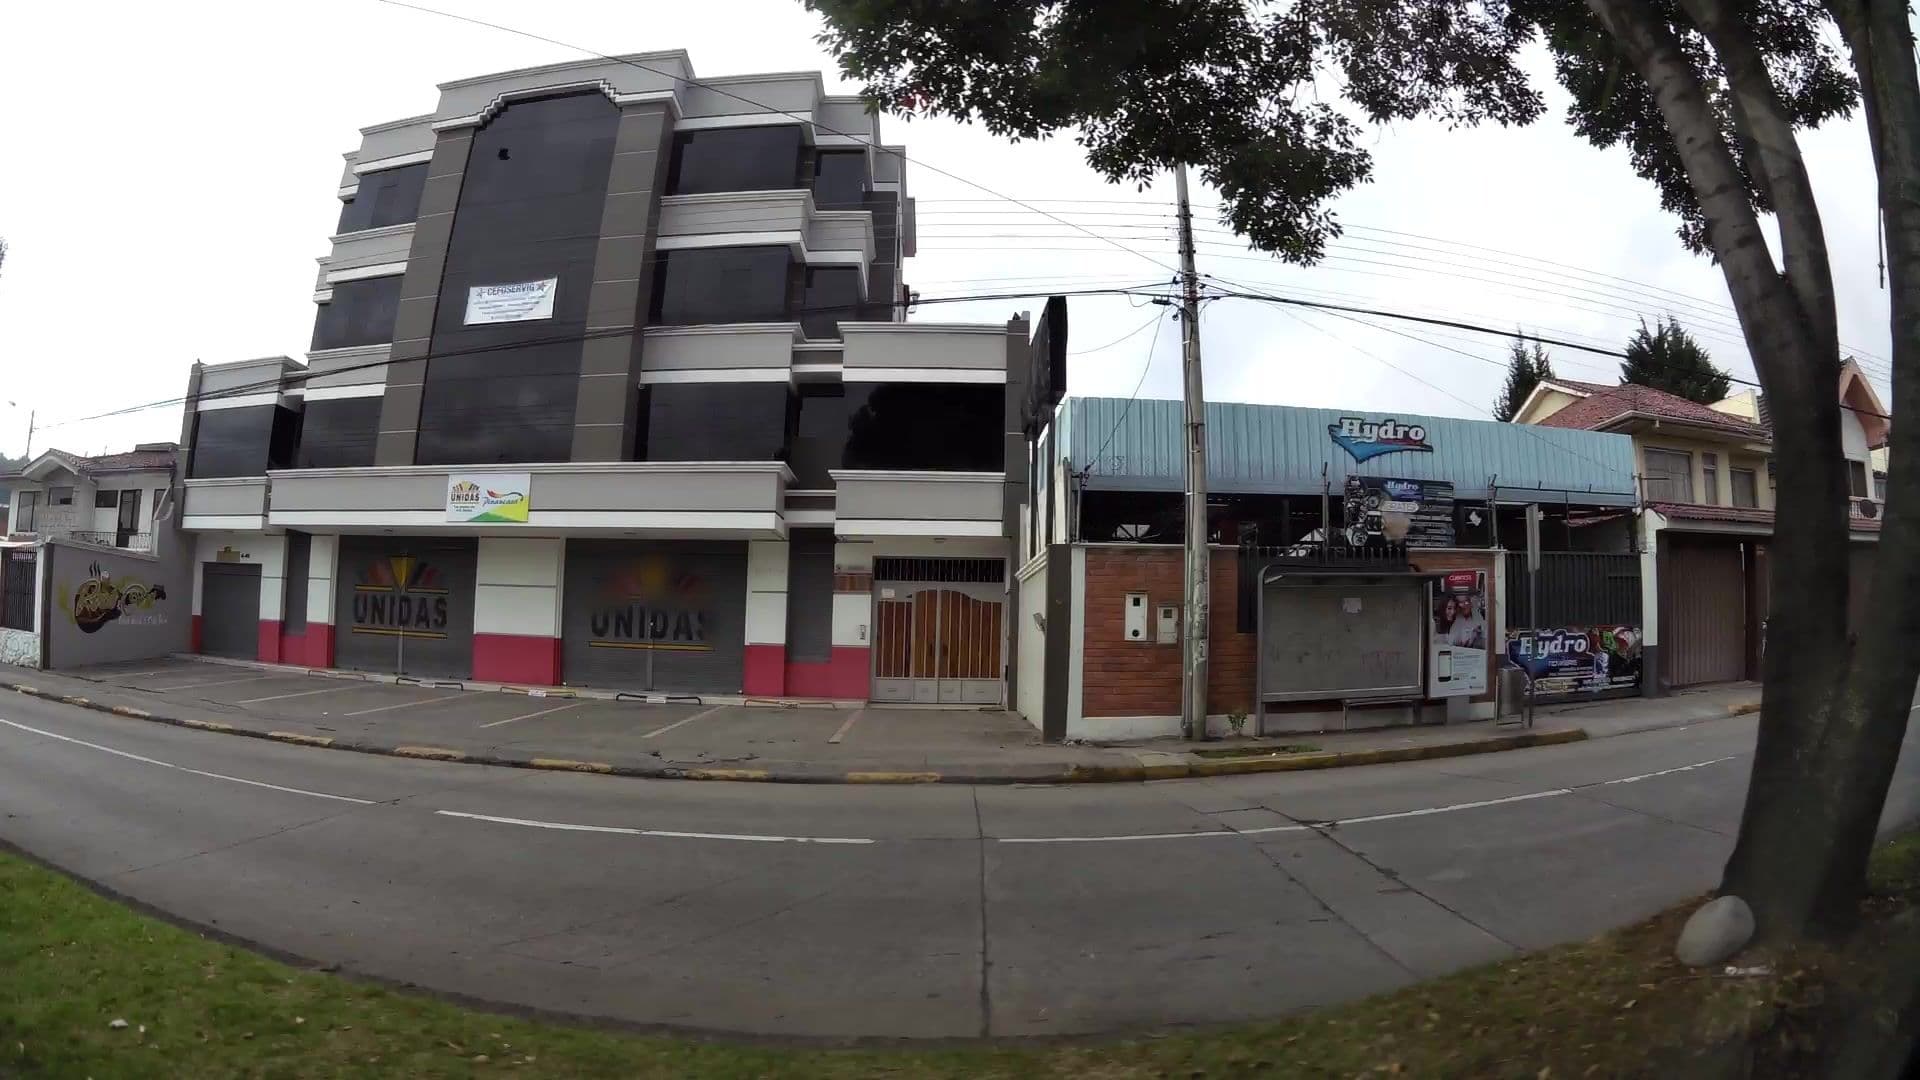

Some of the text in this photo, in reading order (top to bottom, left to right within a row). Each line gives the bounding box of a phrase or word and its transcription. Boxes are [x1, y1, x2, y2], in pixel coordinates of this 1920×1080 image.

[1340, 418, 1425, 444] Hydro
[450, 492, 480, 502] UNIDAS
[353, 593, 448, 628] UNIDAS
[1519, 634, 1587, 660] Hydro
